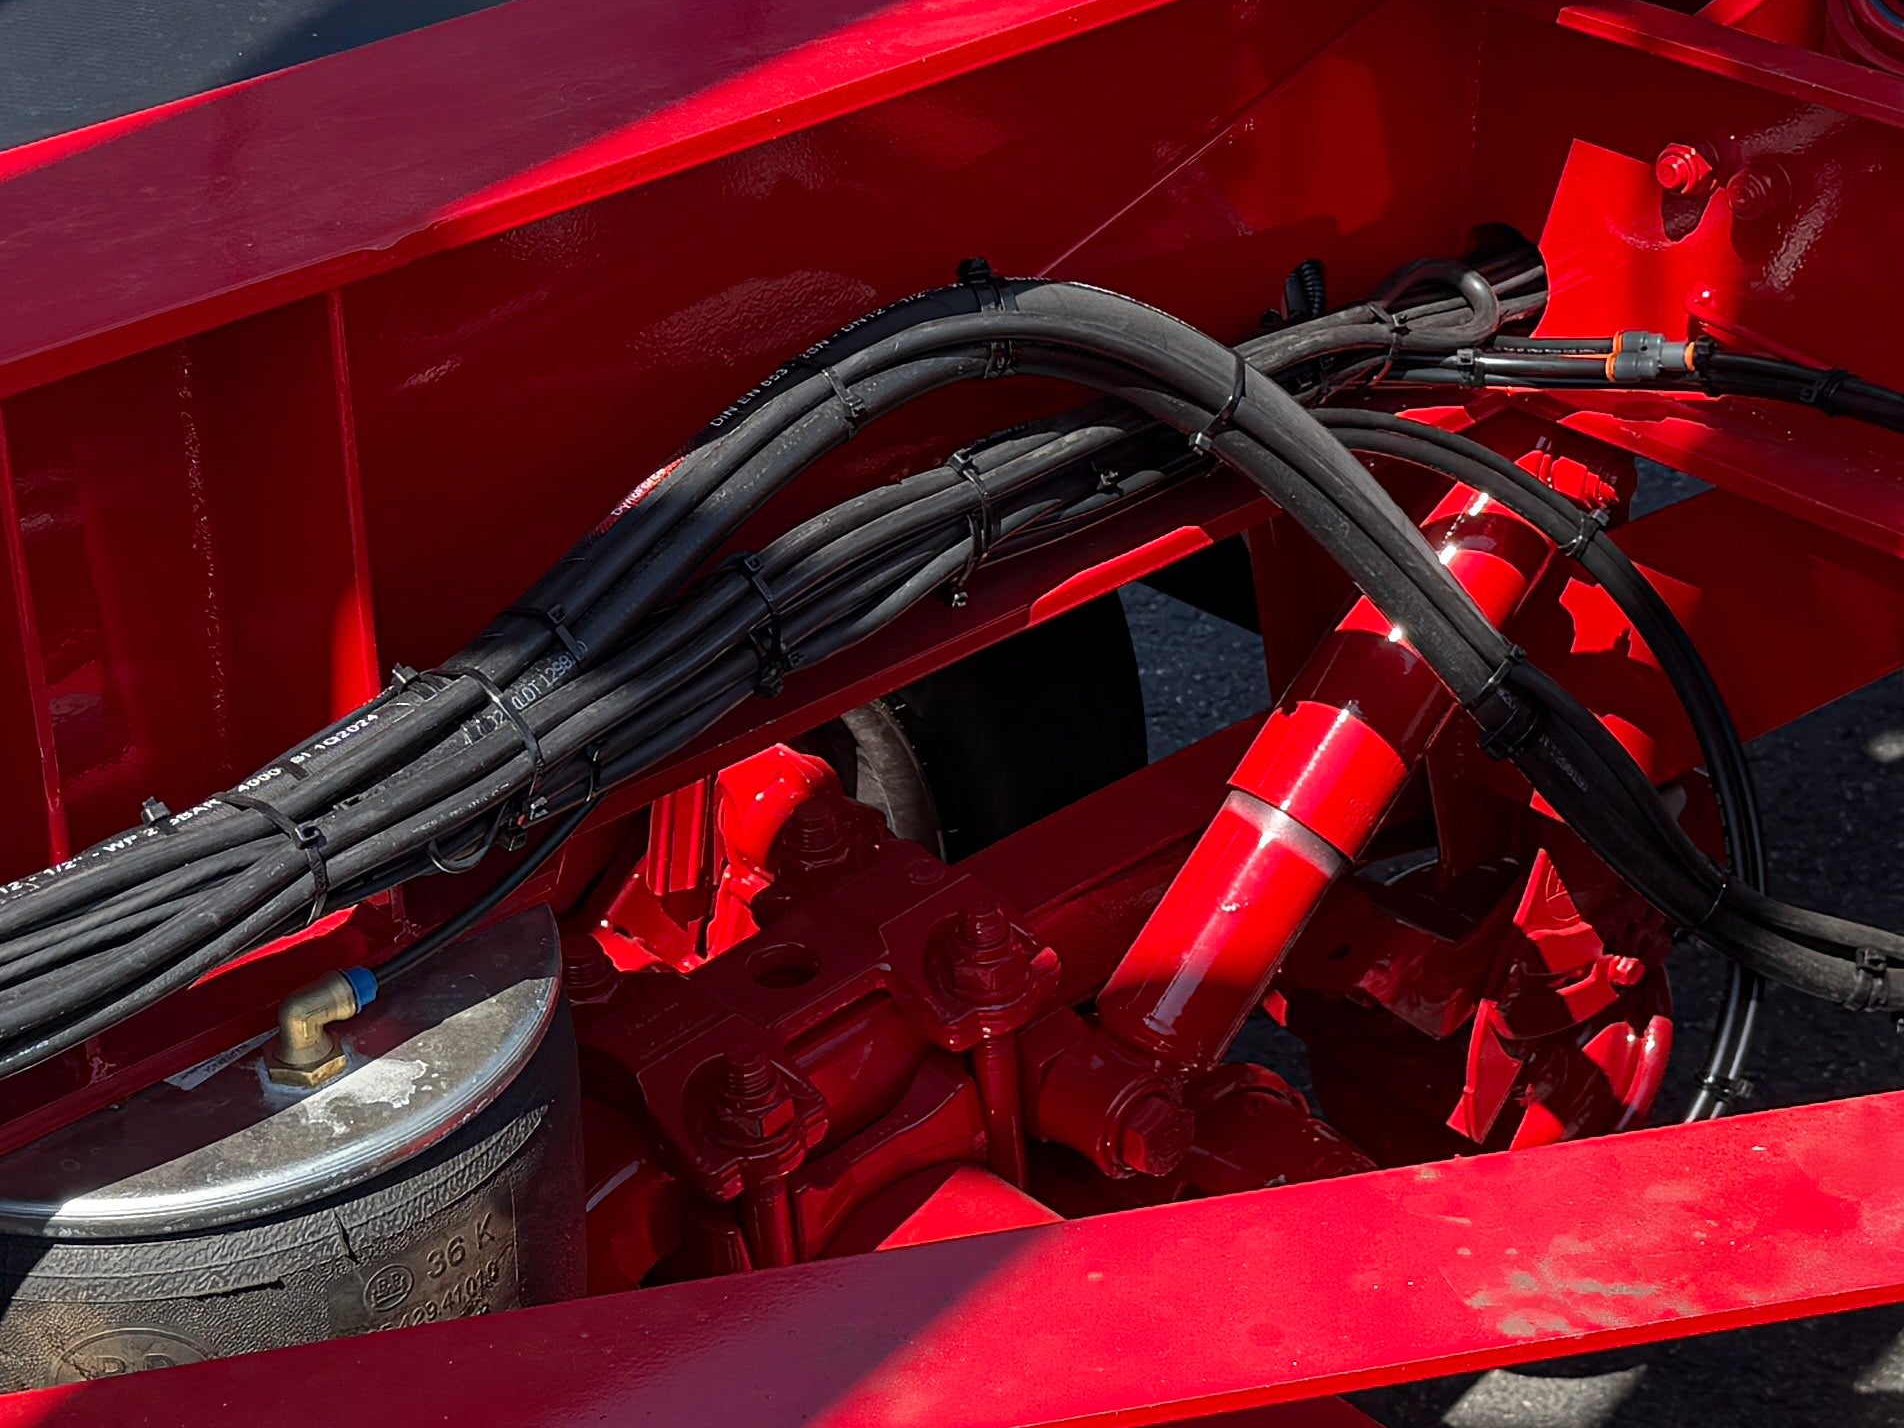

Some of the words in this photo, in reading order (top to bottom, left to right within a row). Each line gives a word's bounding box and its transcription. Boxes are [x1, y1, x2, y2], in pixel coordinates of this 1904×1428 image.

[710, 406, 739, 427] DIN
[102, 834, 138, 853] WP
[314, 713, 380, 750] 1Q2024
[427, 1235, 466, 1278] 36
[475, 1211, 495, 1249] K
